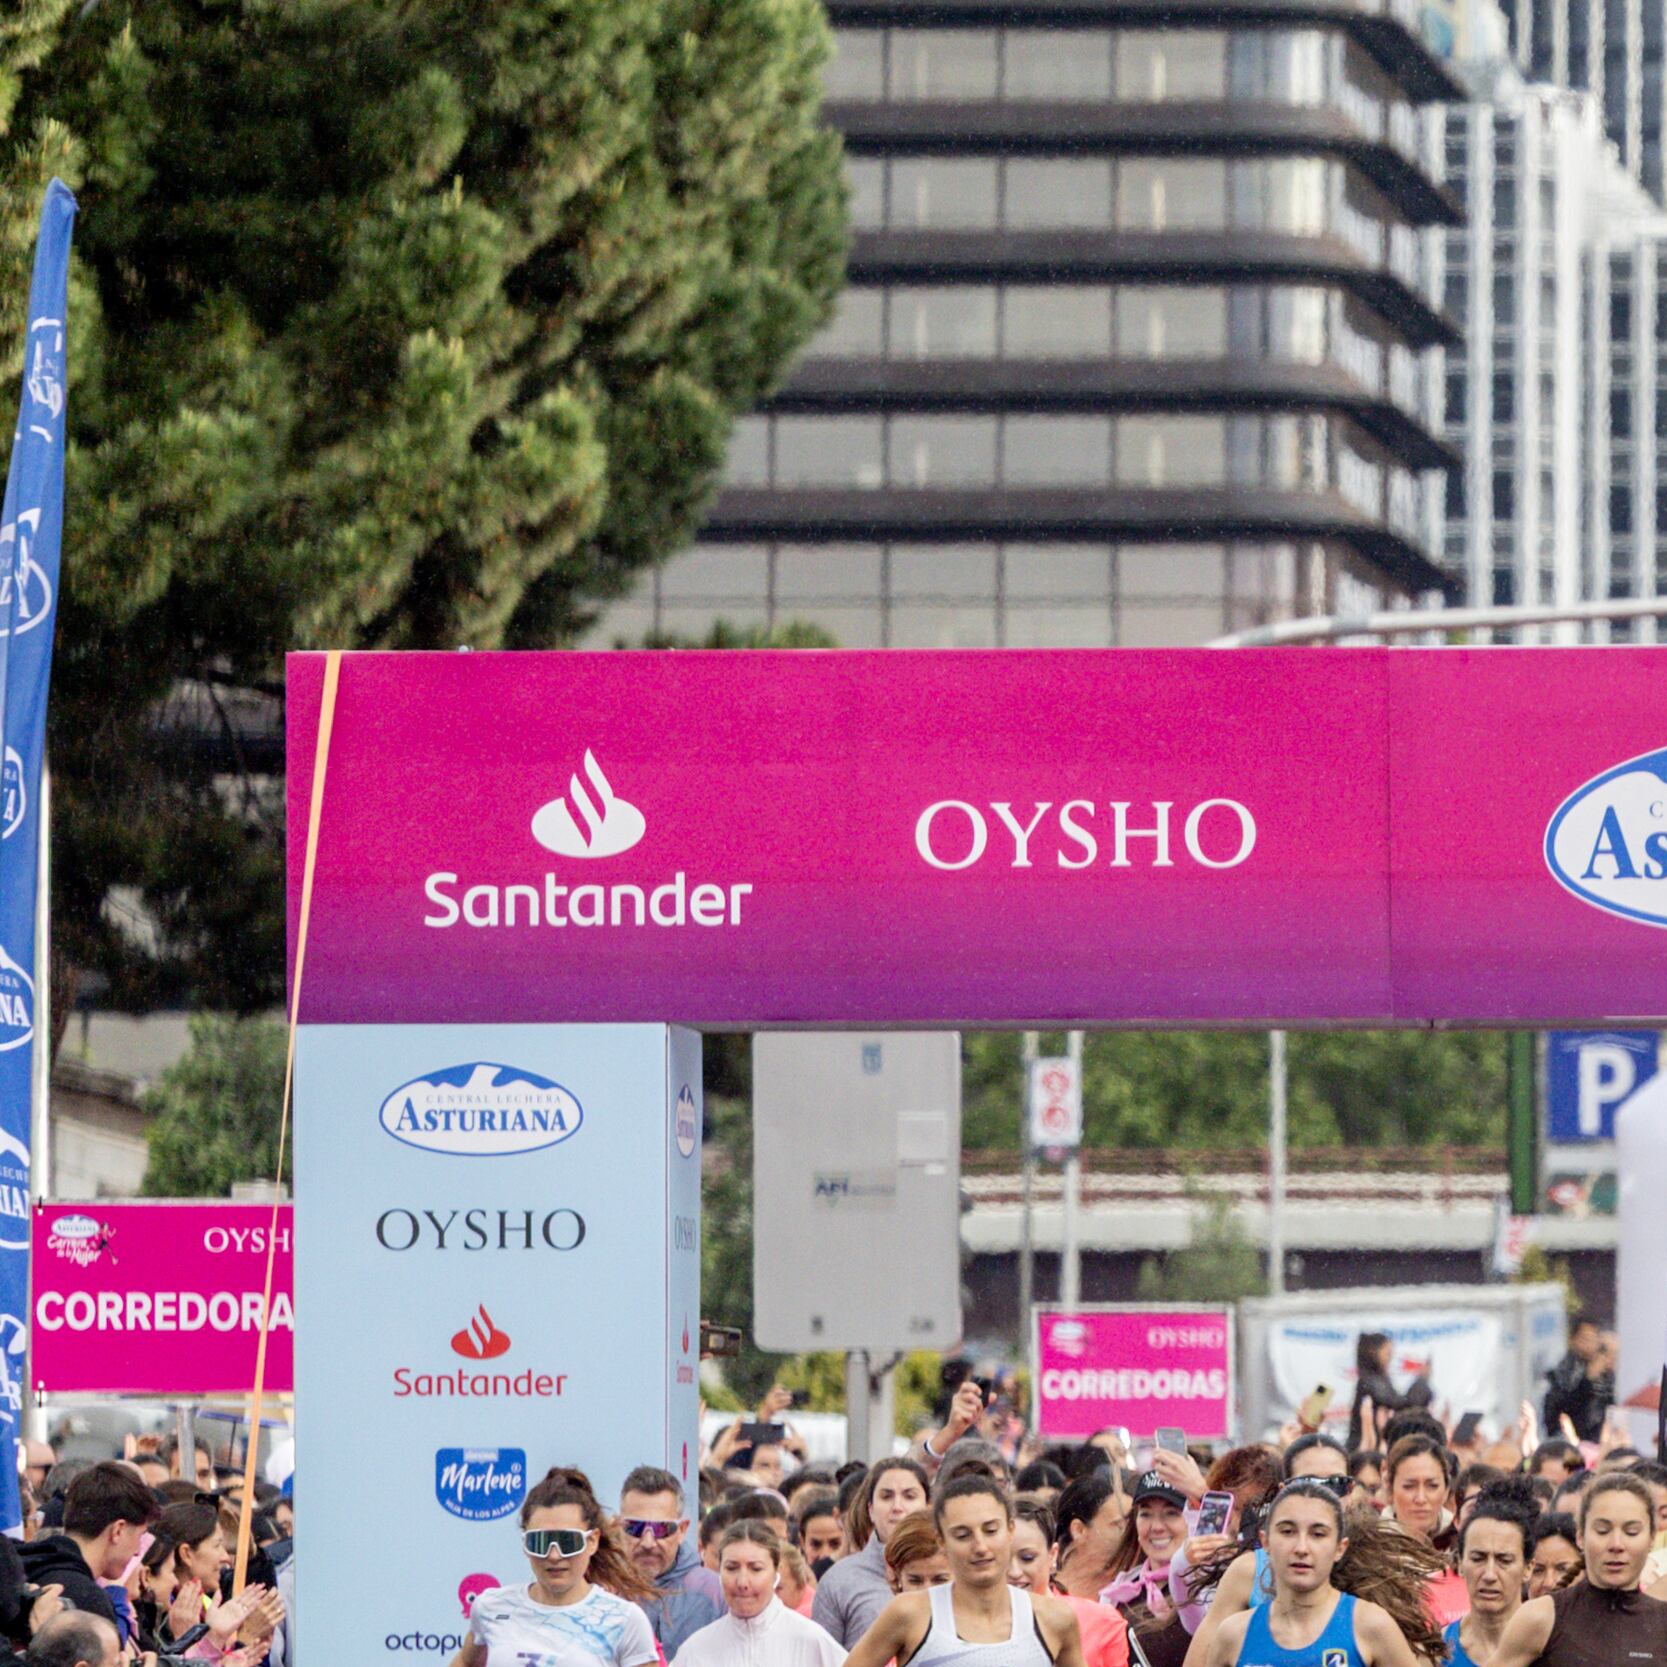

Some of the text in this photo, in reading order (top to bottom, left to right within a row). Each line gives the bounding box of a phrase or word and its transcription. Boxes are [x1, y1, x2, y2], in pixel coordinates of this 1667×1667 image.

[915, 798, 1257, 870] OYSHO
[424, 871, 754, 928] Santander
[426, 1094, 562, 1104] CENTRAL LECHERA
[1577, 1042, 1637, 1136] P
[395, 1096, 568, 1132] ASTURIANA
[203, 1227, 294, 1253] OYSH
[375, 1208, 587, 1251] OYSHO
[36, 1291, 294, 1332] CORREDORA
[1147, 1326, 1226, 1349] OYSHO
[393, 1368, 568, 1397] Santander
[1042, 1367, 1226, 1400] CORREDORAS
[440, 1462, 522, 1502] Marlene
